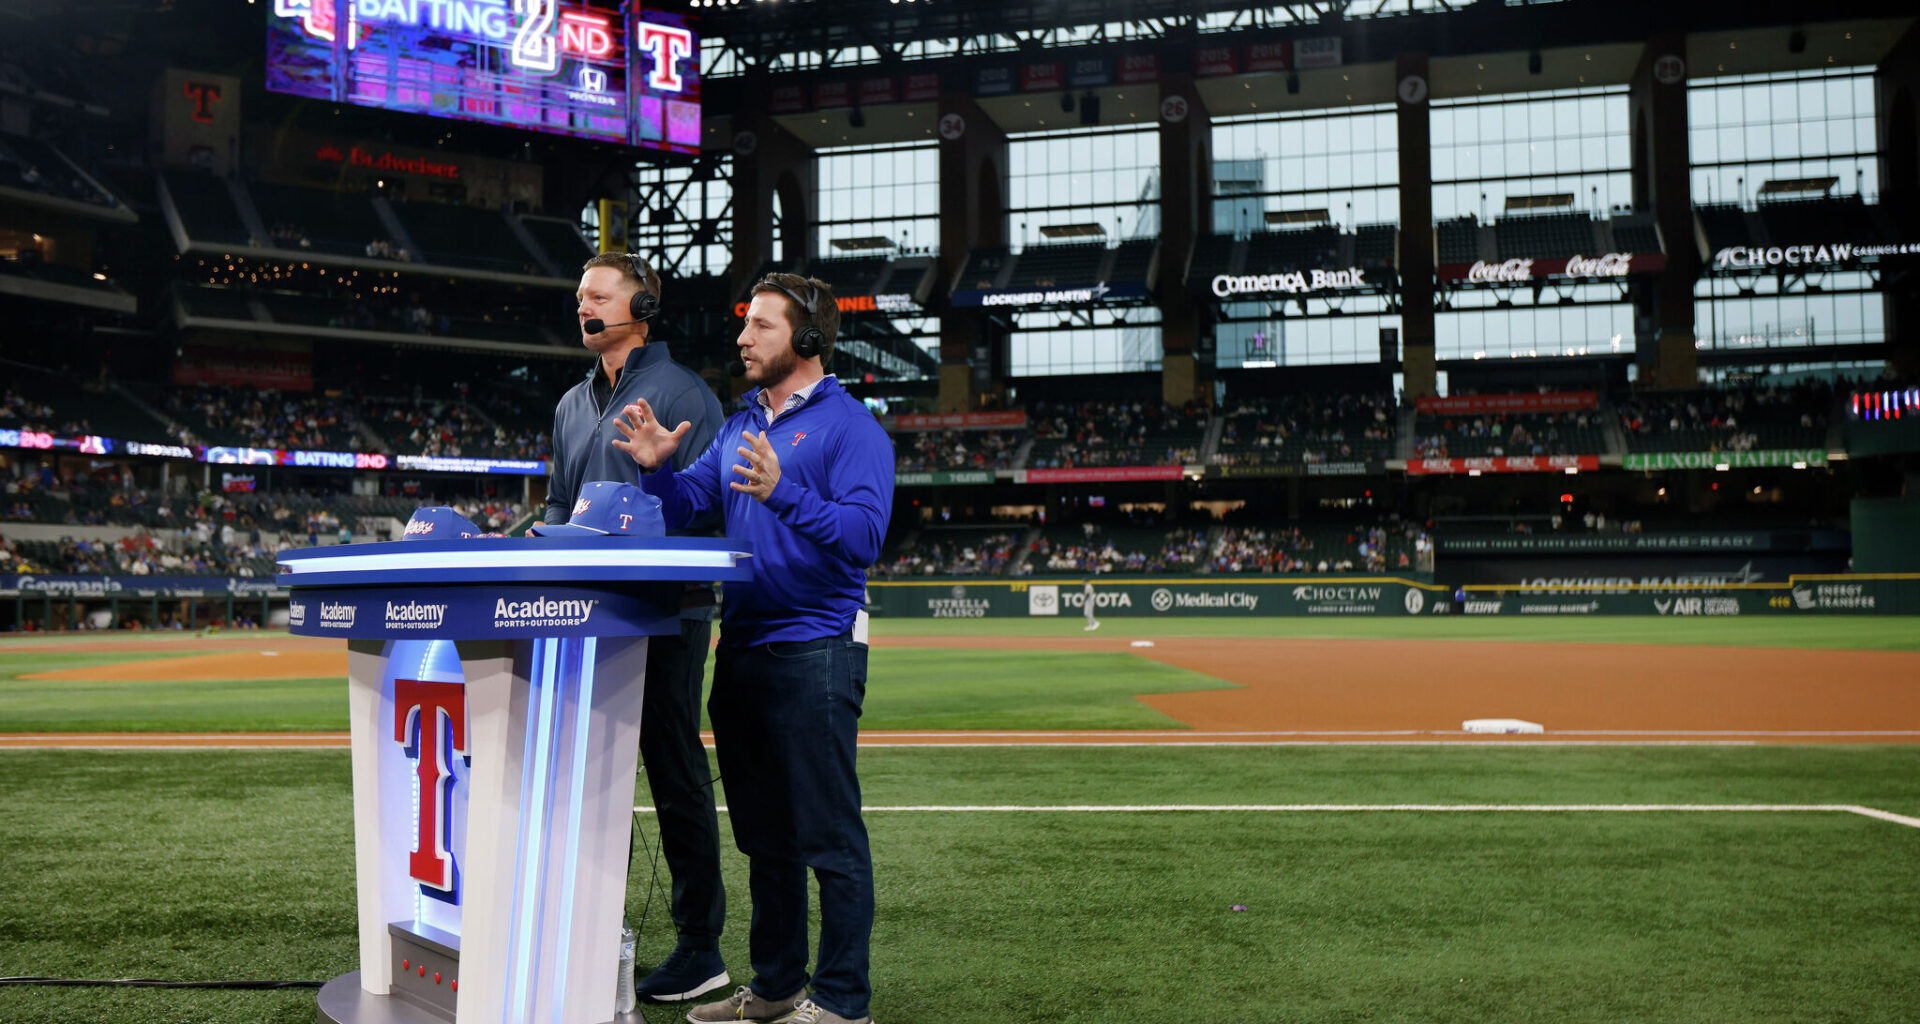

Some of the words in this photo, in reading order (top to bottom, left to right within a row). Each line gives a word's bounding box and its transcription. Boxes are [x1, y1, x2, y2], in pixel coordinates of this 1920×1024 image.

[638, 22, 692, 92] T
[1405, 81, 1418, 97] 7
[1164, 101, 1185, 117] 26
[943, 118, 962, 135] 34
[350, 147, 460, 179] Budweiser
[1729, 243, 1851, 266] CHOCTAW
[1311, 267, 1364, 289] Bank
[982, 292, 1044, 306] LOCKHEED
[1049, 290, 1093, 304] MARTIN
[792, 432, 806, 446] T
[140, 443, 193, 458] HONDA
[295, 451, 355, 468] BATTING
[355, 453, 387, 469] 2ND
[1643, 451, 1715, 470] LUXOR
[1719, 448, 1824, 468] STAFFING
[620, 514, 634, 530] T
[17, 576, 122, 592] Germania
[1519, 577, 1633, 595] LOCKHEED
[1638, 576, 1727, 595] MARTIN
[1817, 585, 1863, 596] ENERGY
[1175, 592, 1229, 607] Medical
[1229, 592, 1258, 610] City
[1301, 586, 1382, 600] CHOCTAW
[494, 596, 594, 623] Academy
[928, 598, 990, 609] ESTRELLA
[1521, 604, 1559, 614] LOCKHEED
[1560, 603, 1589, 614] MARTIN
[1673, 598, 1702, 615] AIR
[1818, 596, 1876, 608] TRANSFER
[320, 602, 356, 625] Academy
[385, 600, 445, 626] Academy
[933, 608, 985, 618] JALISCO
[494, 619, 580, 628] SPORTS+OUTDOORS
[394, 679, 468, 897] T
